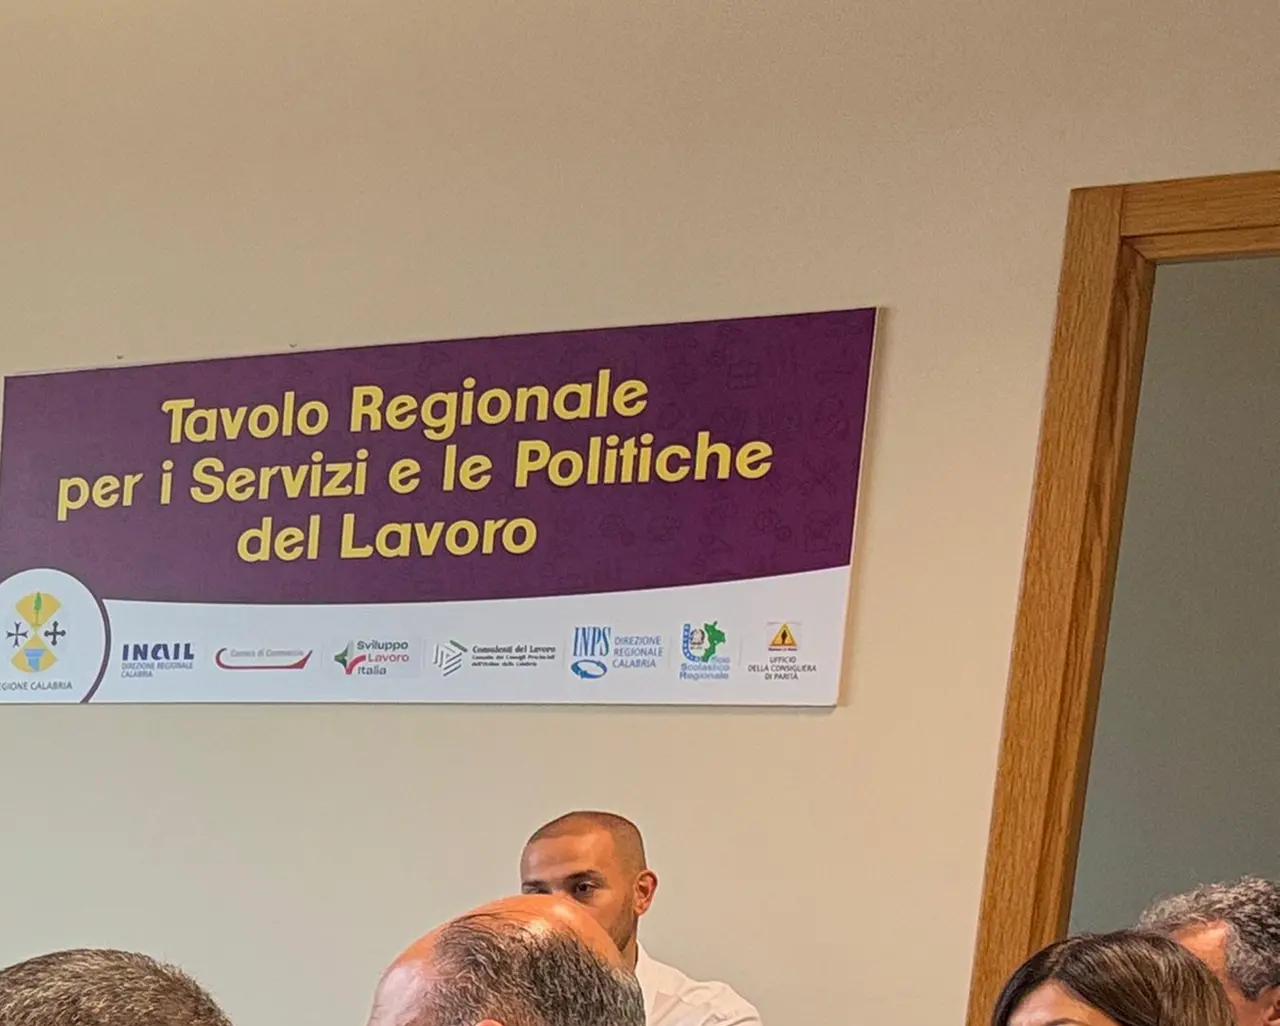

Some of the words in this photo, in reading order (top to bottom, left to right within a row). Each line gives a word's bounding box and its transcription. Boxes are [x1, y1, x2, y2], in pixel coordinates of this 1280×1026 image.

[161, 391, 329, 443] Tavolo
[350, 368, 648, 440] Regionale
[57, 473, 144, 522] per
[160, 459, 174, 504] i
[190, 448, 369, 503] Servizi
[389, 458, 421, 494] e
[443, 444, 493, 491] le
[515, 431, 773, 488] Politiche
[237, 516, 320, 562] del
[340, 512, 538, 559] Lavoro
[573, 626, 611, 656] INPS
[614, 636, 661, 645] DIREZIONE
[357, 640, 409, 651] Sviluppo
[122, 643, 194, 660] INAIL
[614, 647, 663, 656] REGIONALE
[368, 653, 410, 662] Lavoro
[769, 656, 797, 664] UFFICIO
[612, 659, 656, 668] CALABRIA
[748, 664, 769, 672] DELLA
[358, 665, 387, 675] Italia
[679, 671, 729, 680] Regionale
[765, 672, 772, 680] DI
[31, 681, 72, 690] CALABRIA
